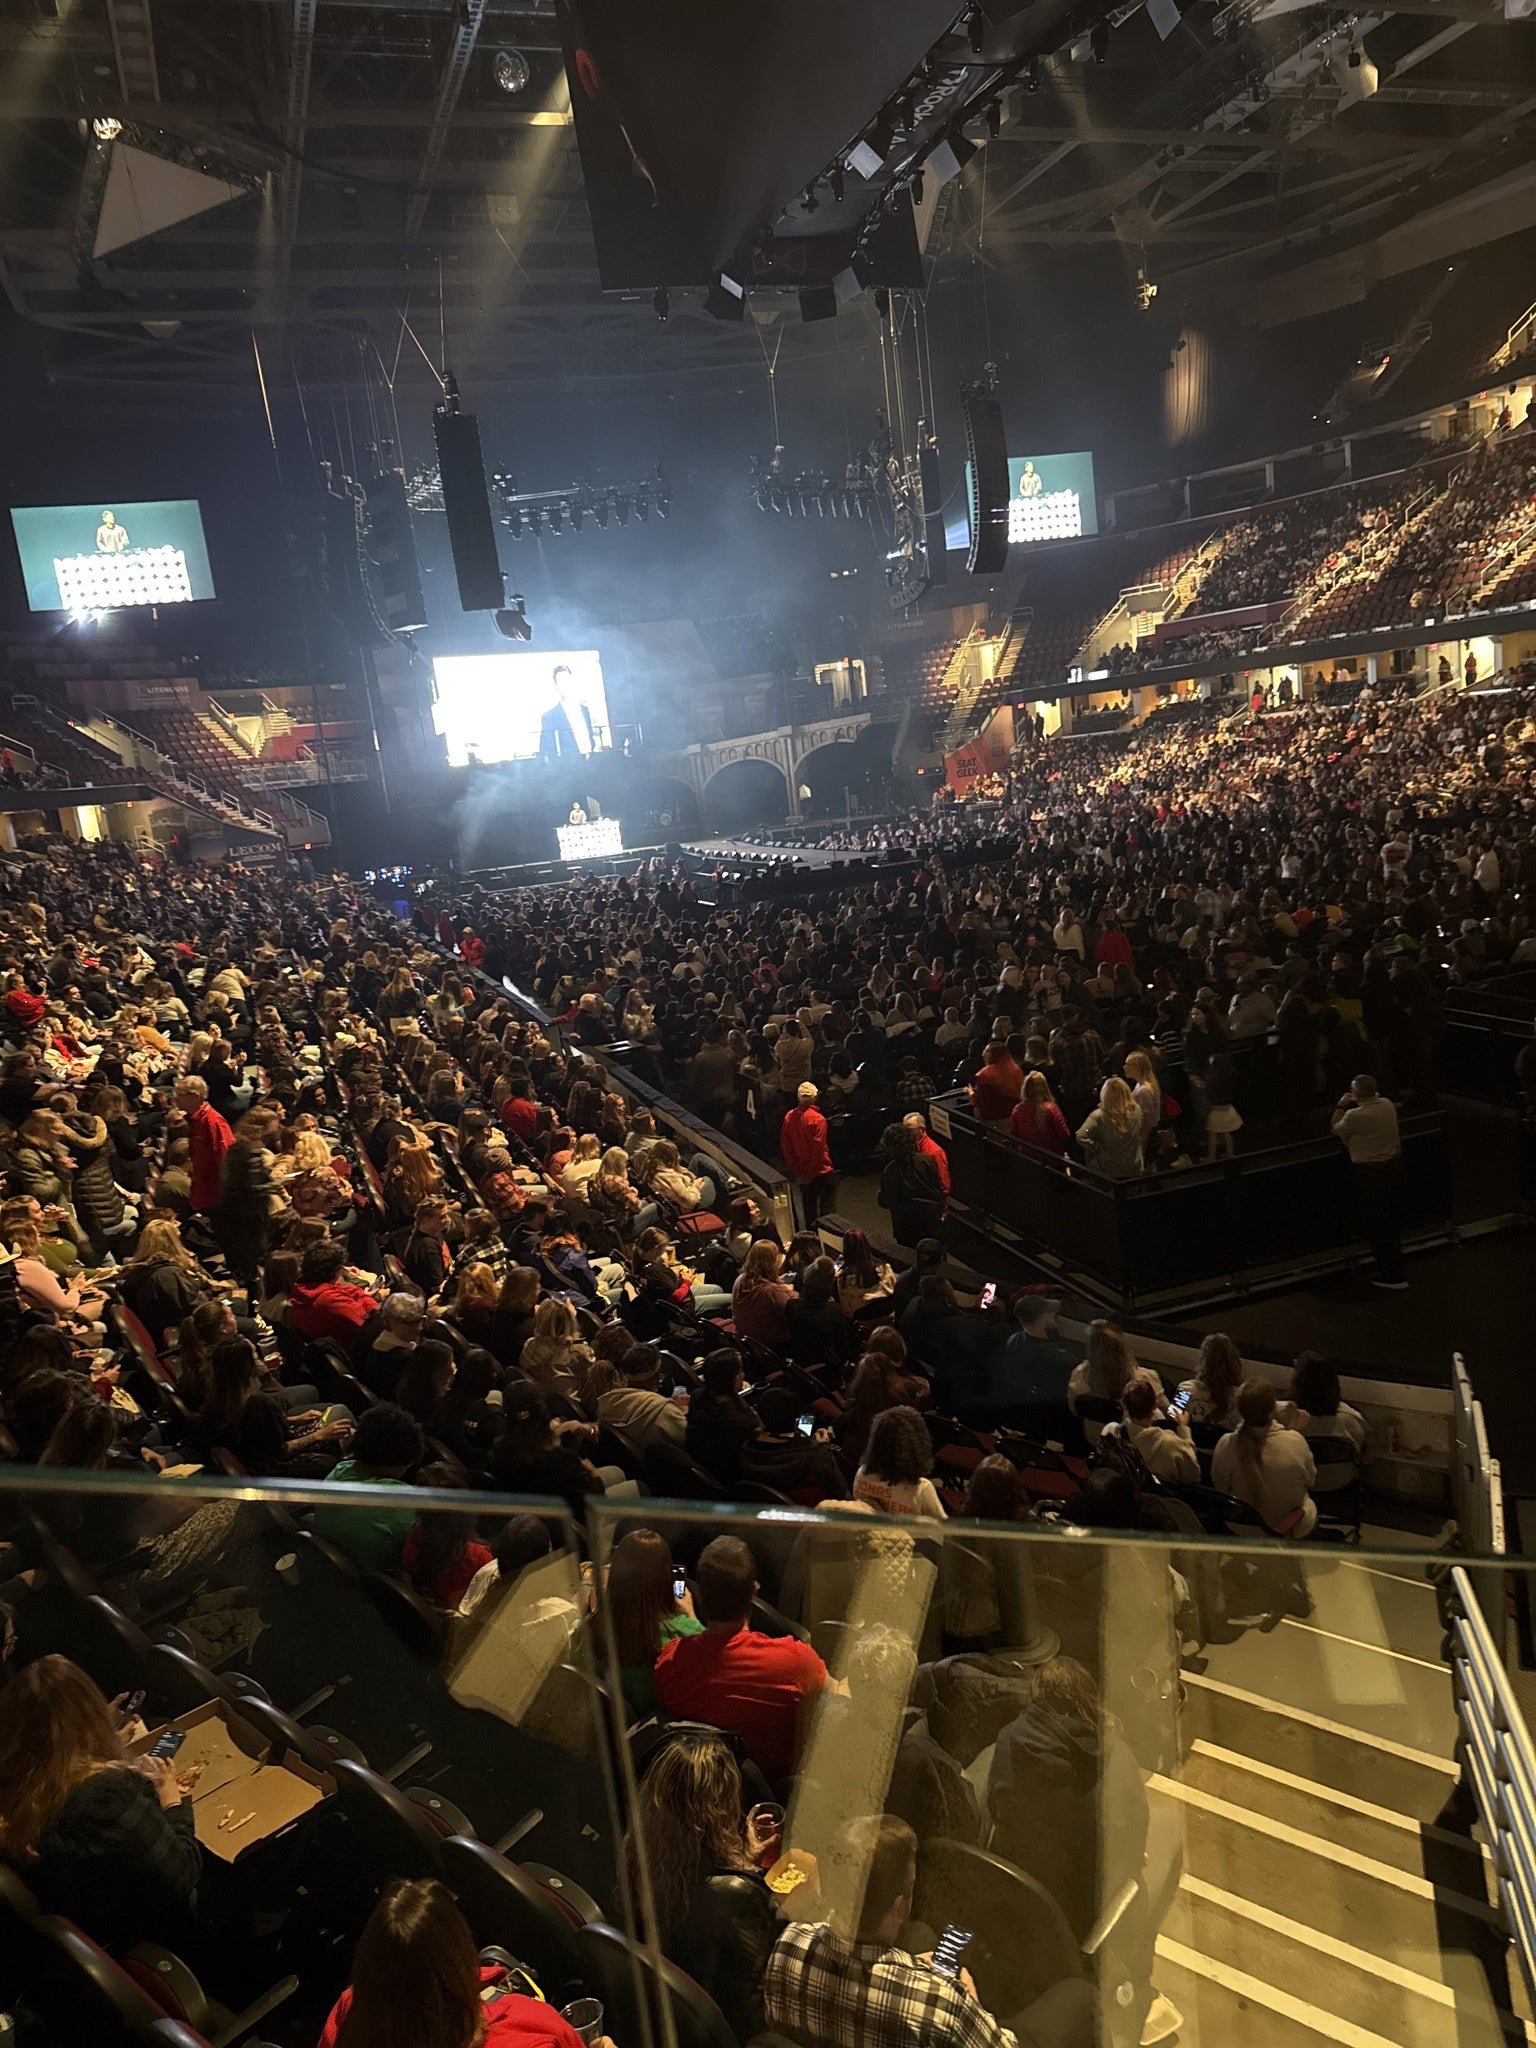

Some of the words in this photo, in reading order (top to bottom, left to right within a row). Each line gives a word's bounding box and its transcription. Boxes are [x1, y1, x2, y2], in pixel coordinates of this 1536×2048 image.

[957, 757, 977, 768] SEAT
[957, 767, 979, 778] GEEK
[229, 842, 282, 857] LECOM
[1234, 839, 1244, 855] 3
[908, 892, 918, 908] 2
[583, 944, 593, 961] 1
[746, 1089, 757, 1120] 4
